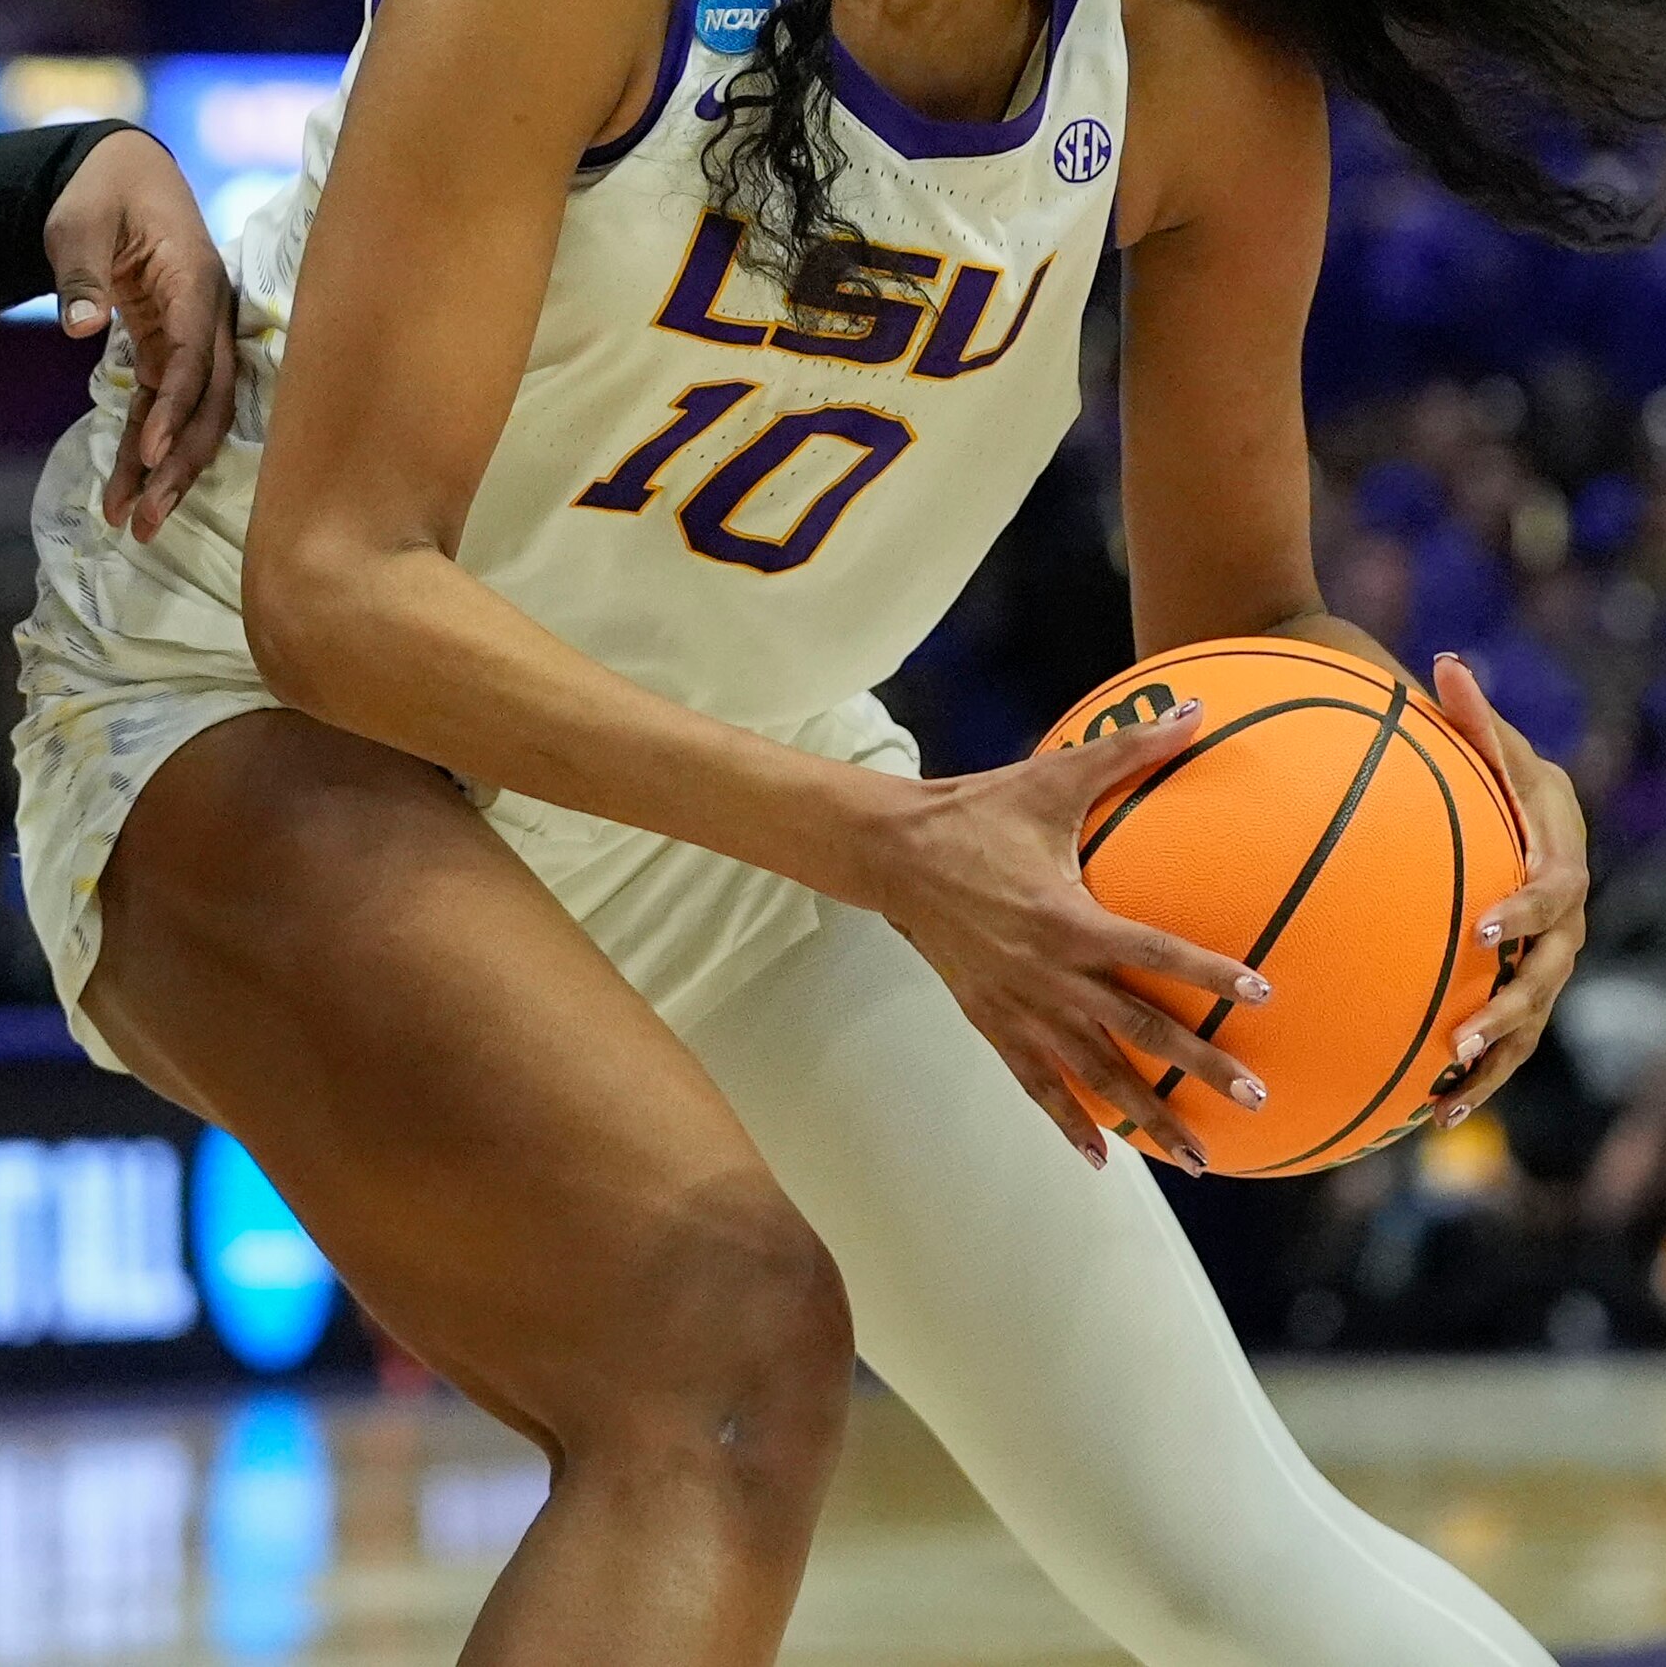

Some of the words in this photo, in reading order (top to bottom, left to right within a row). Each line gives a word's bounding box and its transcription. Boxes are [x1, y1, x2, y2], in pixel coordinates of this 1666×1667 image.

[1056, 120, 1111, 182] SEC
[650, 207, 1058, 382] LSU
[570, 378, 919, 576] 10
